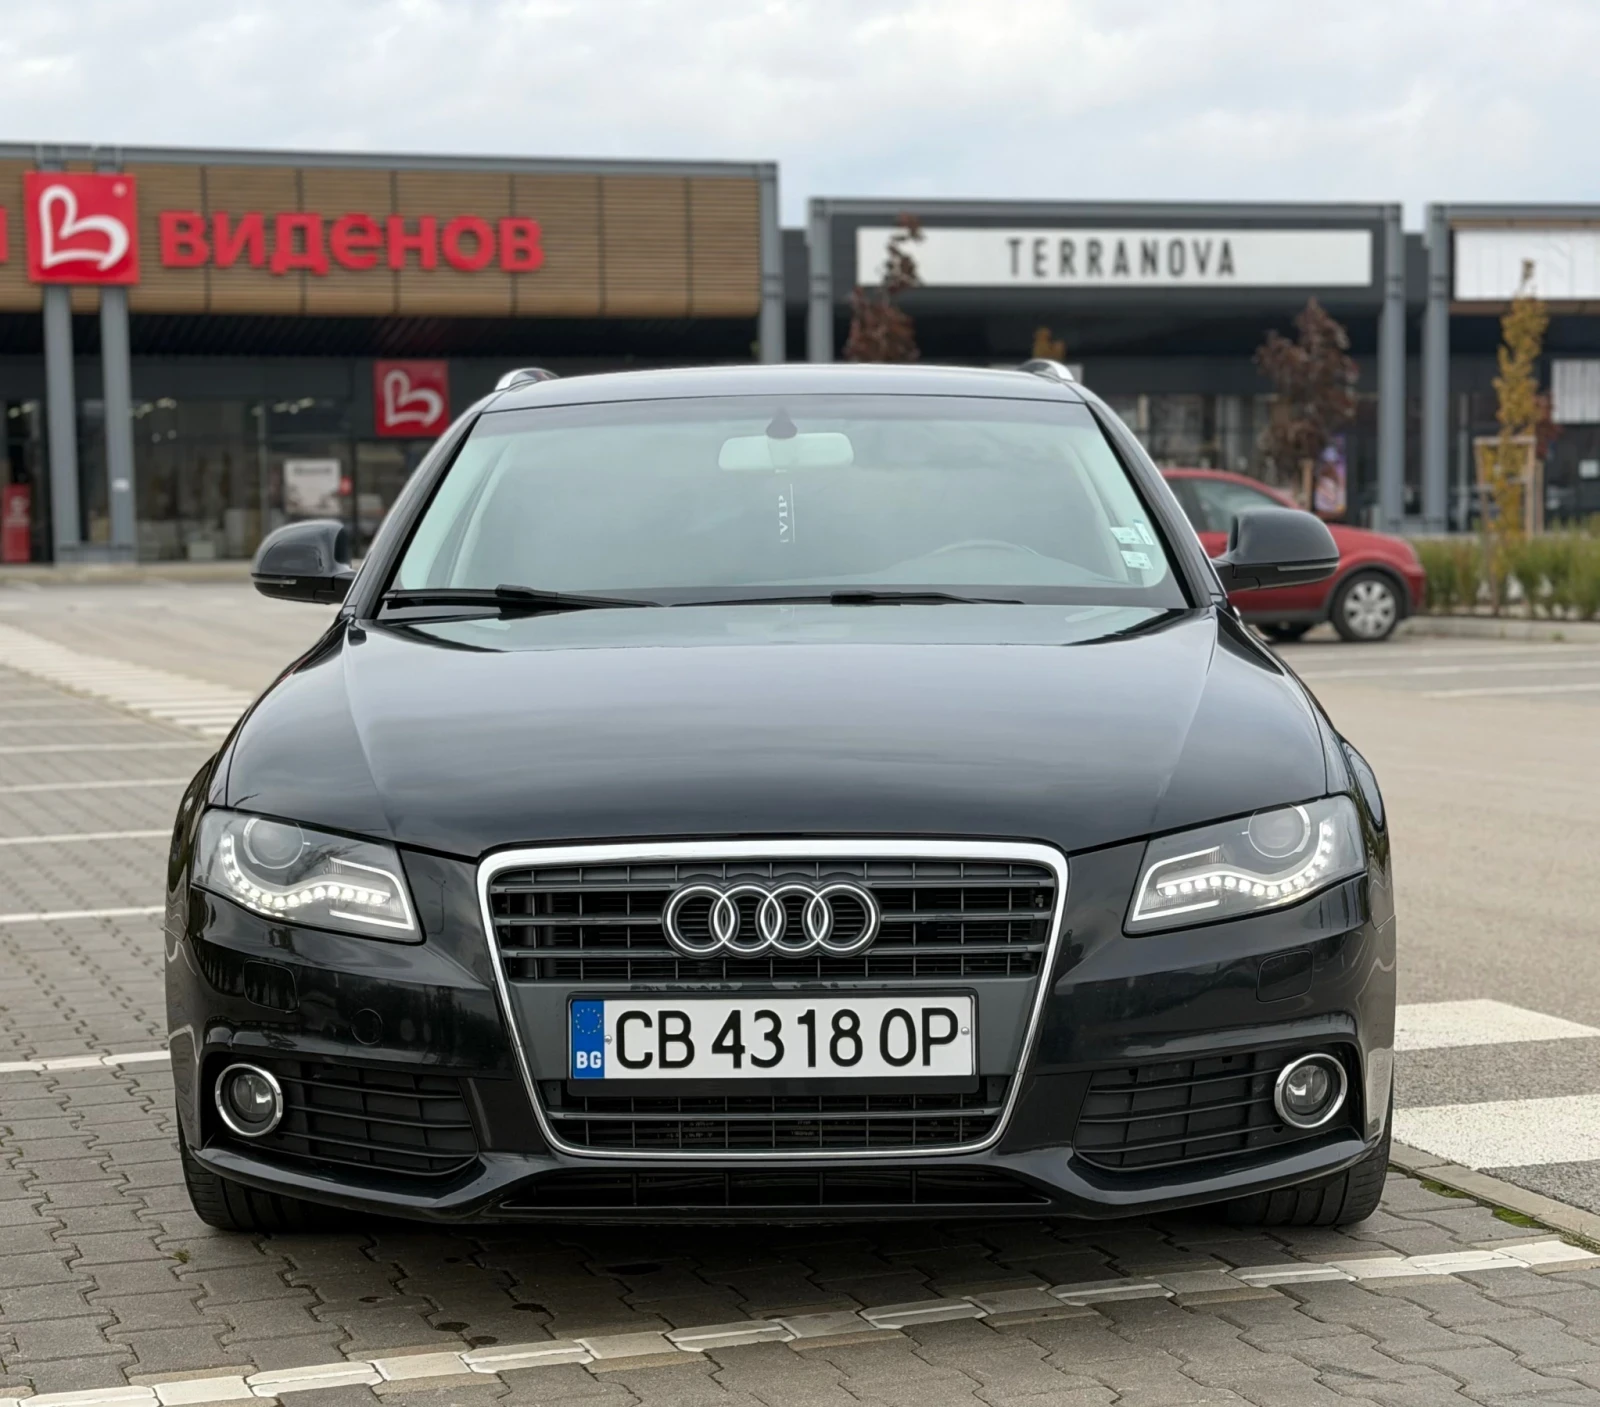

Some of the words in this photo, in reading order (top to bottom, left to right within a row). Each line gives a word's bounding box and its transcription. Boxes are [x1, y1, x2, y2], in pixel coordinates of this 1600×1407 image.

[1006, 237, 1236, 277] TERRANOVA
[615, 1010, 695, 1069] CB
[711, 1009, 863, 1069] 4318
[879, 1007, 959, 1067] OP
[576, 1051, 602, 1069] BG
